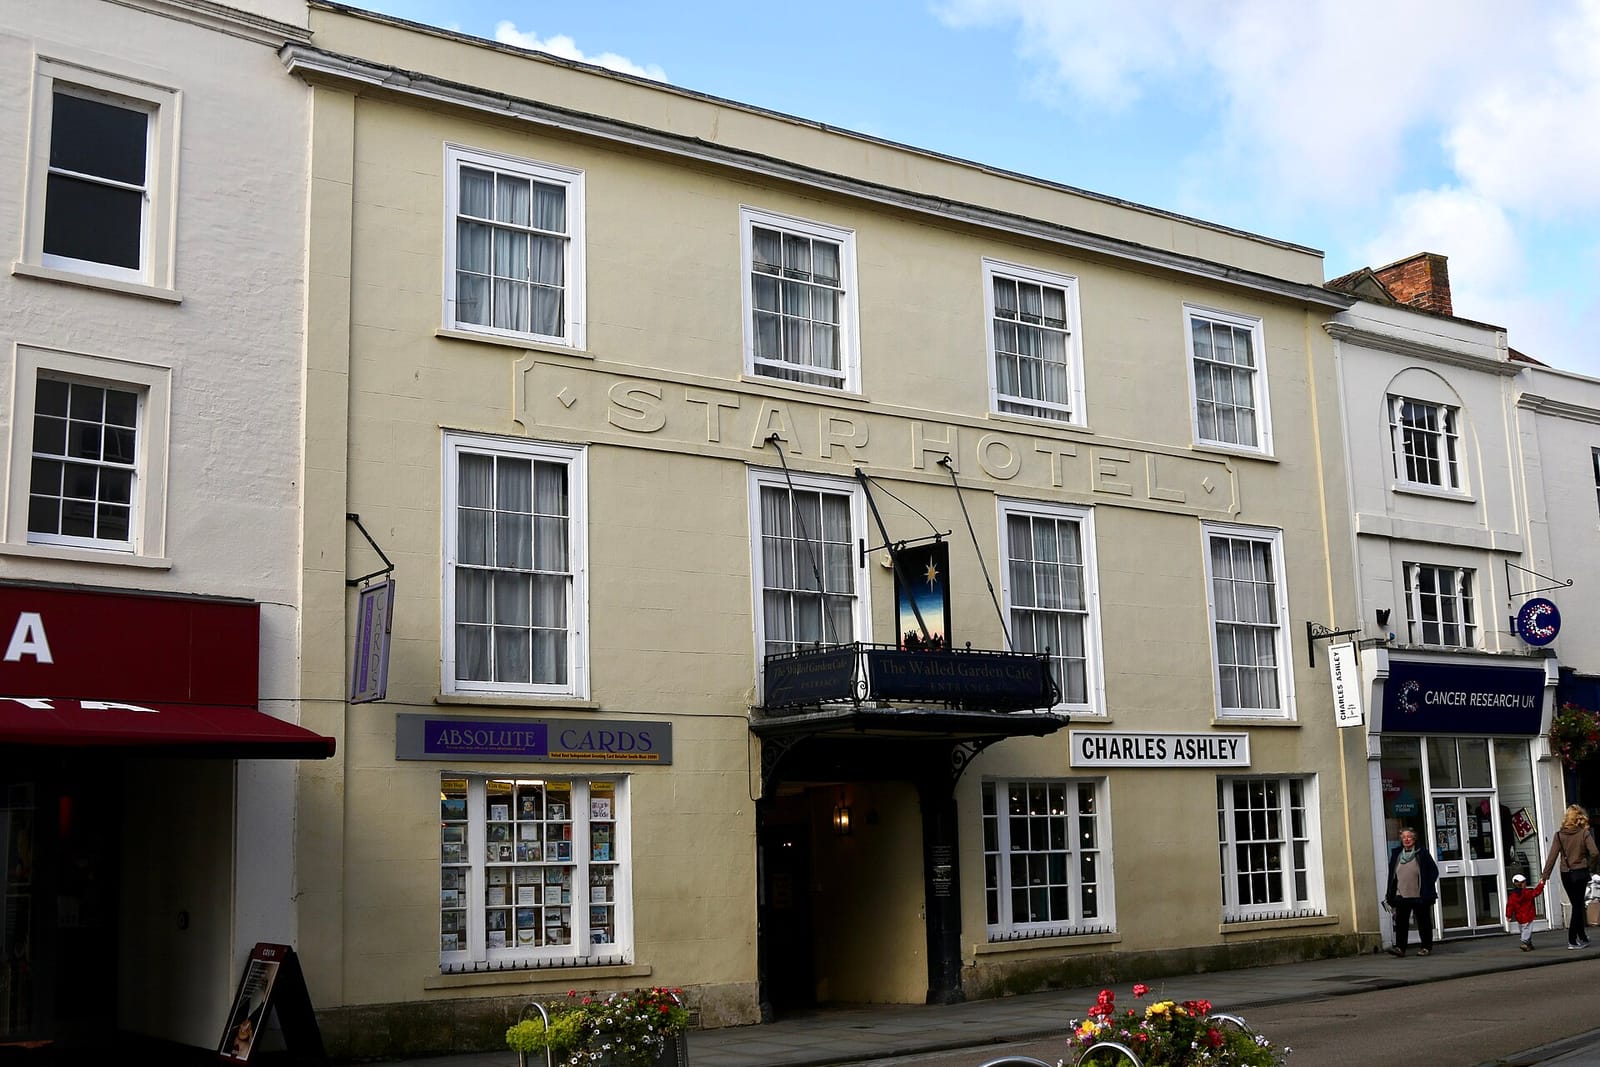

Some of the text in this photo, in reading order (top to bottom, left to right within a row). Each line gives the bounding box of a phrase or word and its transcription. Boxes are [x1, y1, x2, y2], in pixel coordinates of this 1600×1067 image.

[608, 380, 1185, 503] STAR HOTEL
[3, 611, 54, 664] A
[370, 591, 385, 691] CARDS
[879, 659, 906, 674] The
[908, 660, 955, 676] Walled
[958, 662, 1003, 678] Garden
[1333, 652, 1346, 720] CHARLES ASHLEY
[1425, 690, 1535, 708] CANCER RESEARCH UK
[436, 729, 652, 752] ABSOLUTE CARDS
[1082, 737, 1238, 760] CHARLES ASHLEY
